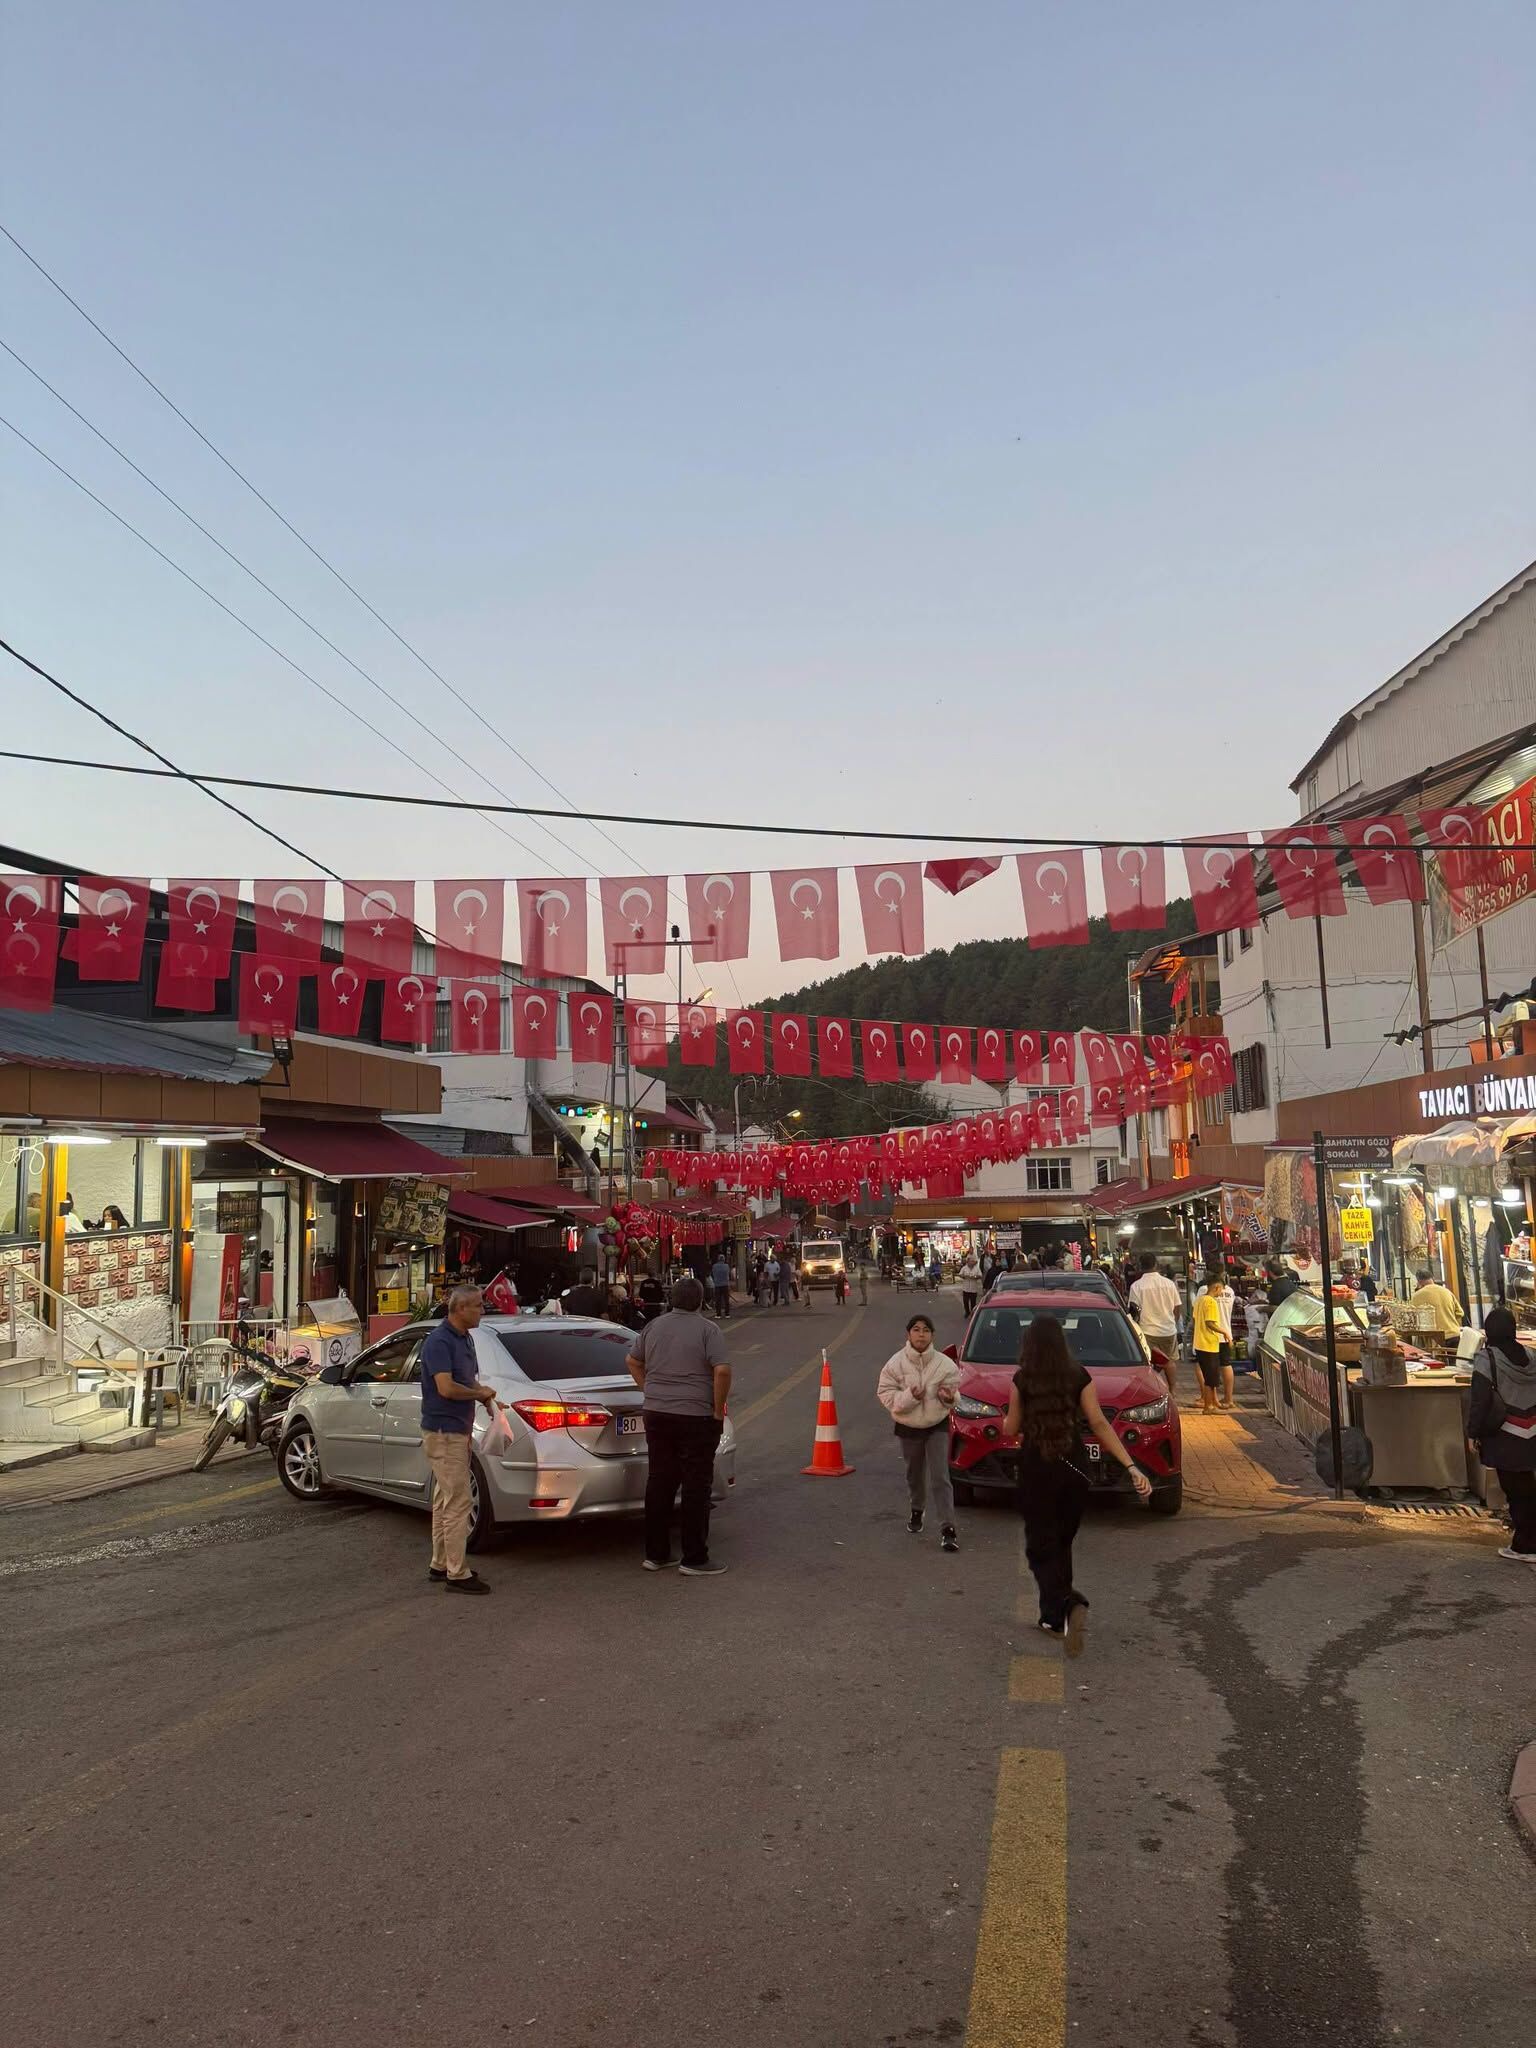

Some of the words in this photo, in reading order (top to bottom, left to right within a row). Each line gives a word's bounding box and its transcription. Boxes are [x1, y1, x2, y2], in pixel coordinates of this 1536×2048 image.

[1478, 891, 1497, 918] 255
[1499, 883, 1513, 907] 99
[1515, 873, 1529, 899] 63
[1419, 1084, 1470, 1118] TAVACI
[1326, 1139, 1366, 1147] BAHRATIN
[1367, 1138, 1390, 1146] GÖZÜ
[1326, 1149, 1359, 1158] SOKAĞI
[1347, 1211, 1365, 1219] TAZE
[1345, 1221, 1369, 1230] KAHVE
[623, 1418, 637, 1431] 80
